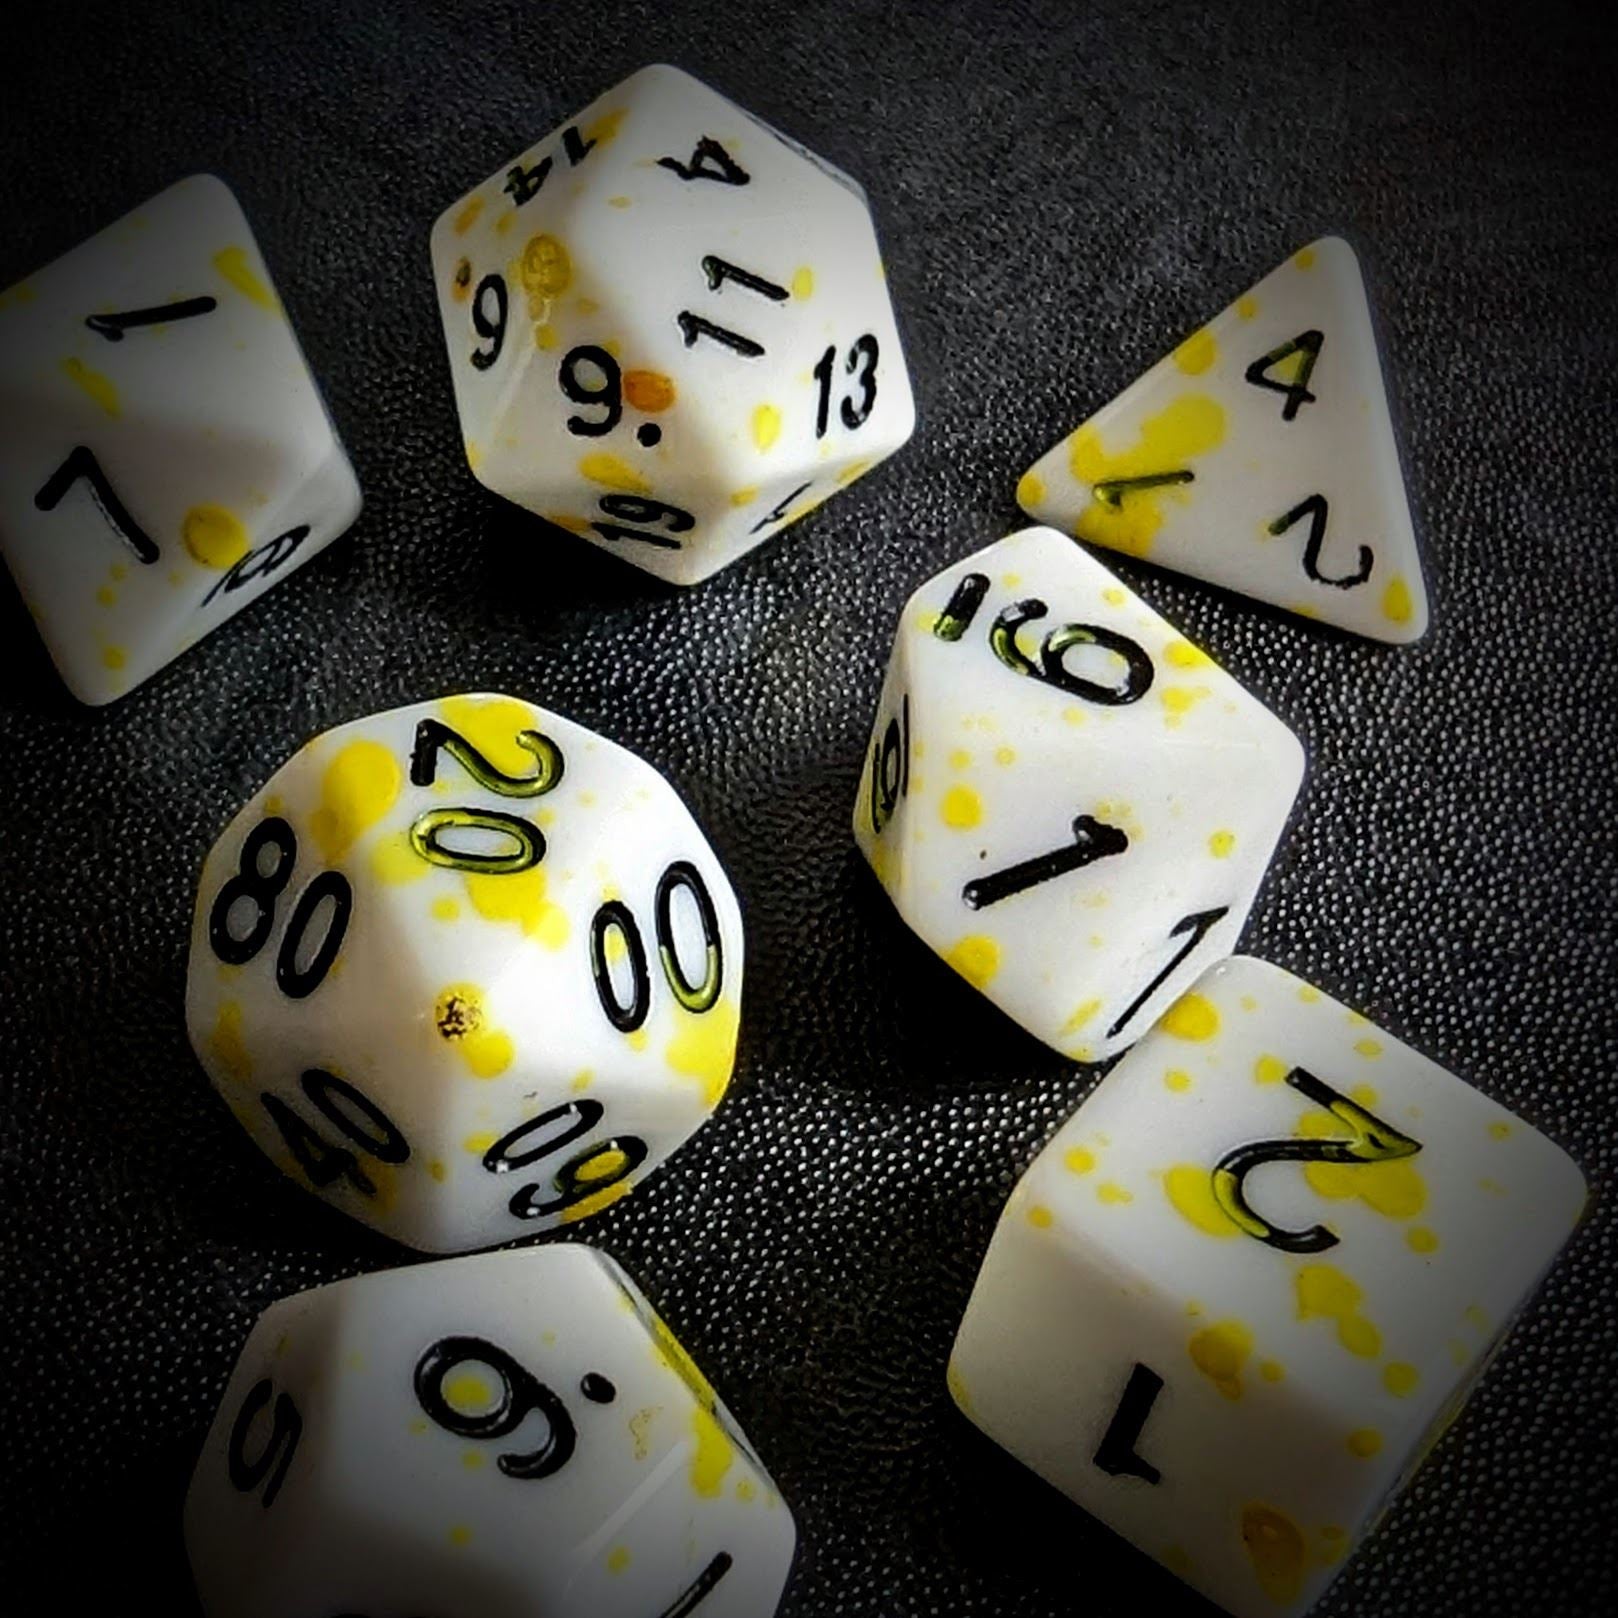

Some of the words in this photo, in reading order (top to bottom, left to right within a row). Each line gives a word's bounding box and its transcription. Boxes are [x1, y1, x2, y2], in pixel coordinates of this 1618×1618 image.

[656, 136, 751, 186] 4
[86, 296, 217, 342] 1
[676, 254, 790, 359] 11
[813, 333, 879, 440] 13
[1245, 330, 1324, 421] 4
[34, 446, 160, 566] 7
[589, 494, 696, 550] 19
[1092, 470, 1195, 512] 1
[1268, 494, 1374, 590] 2
[410, 718, 565, 875] 20
[209, 817, 352, 999] 80
[962, 814, 1129, 911] 1
[590, 861, 723, 1034] 00
[260, 1069, 410, 1196] 40
[1211, 1066, 1423, 1253] 2
[1094, 1362, 1164, 1485] 1
